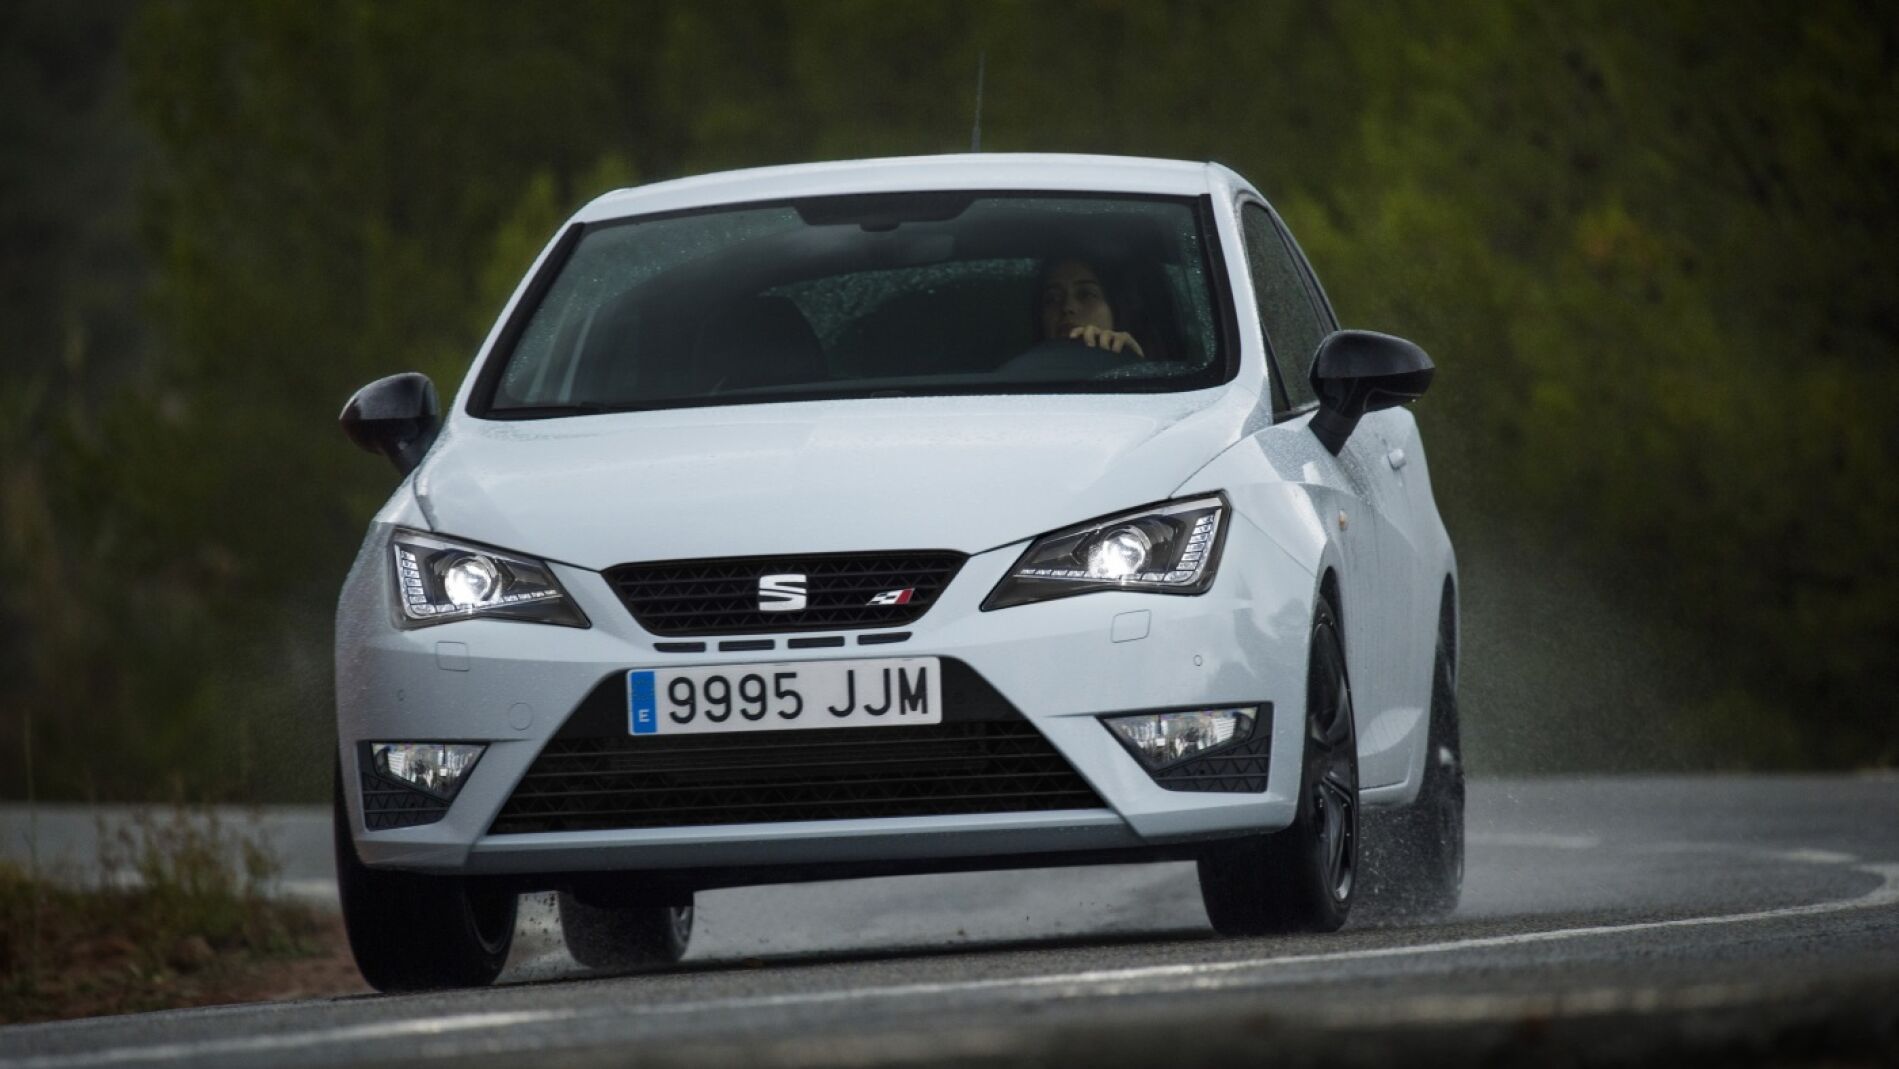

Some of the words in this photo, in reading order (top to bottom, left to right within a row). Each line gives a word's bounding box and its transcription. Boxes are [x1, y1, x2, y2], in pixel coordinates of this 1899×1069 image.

[667, 672, 803, 724] 9995
[827, 667, 928, 718] JJM
[639, 709, 650, 723] E
